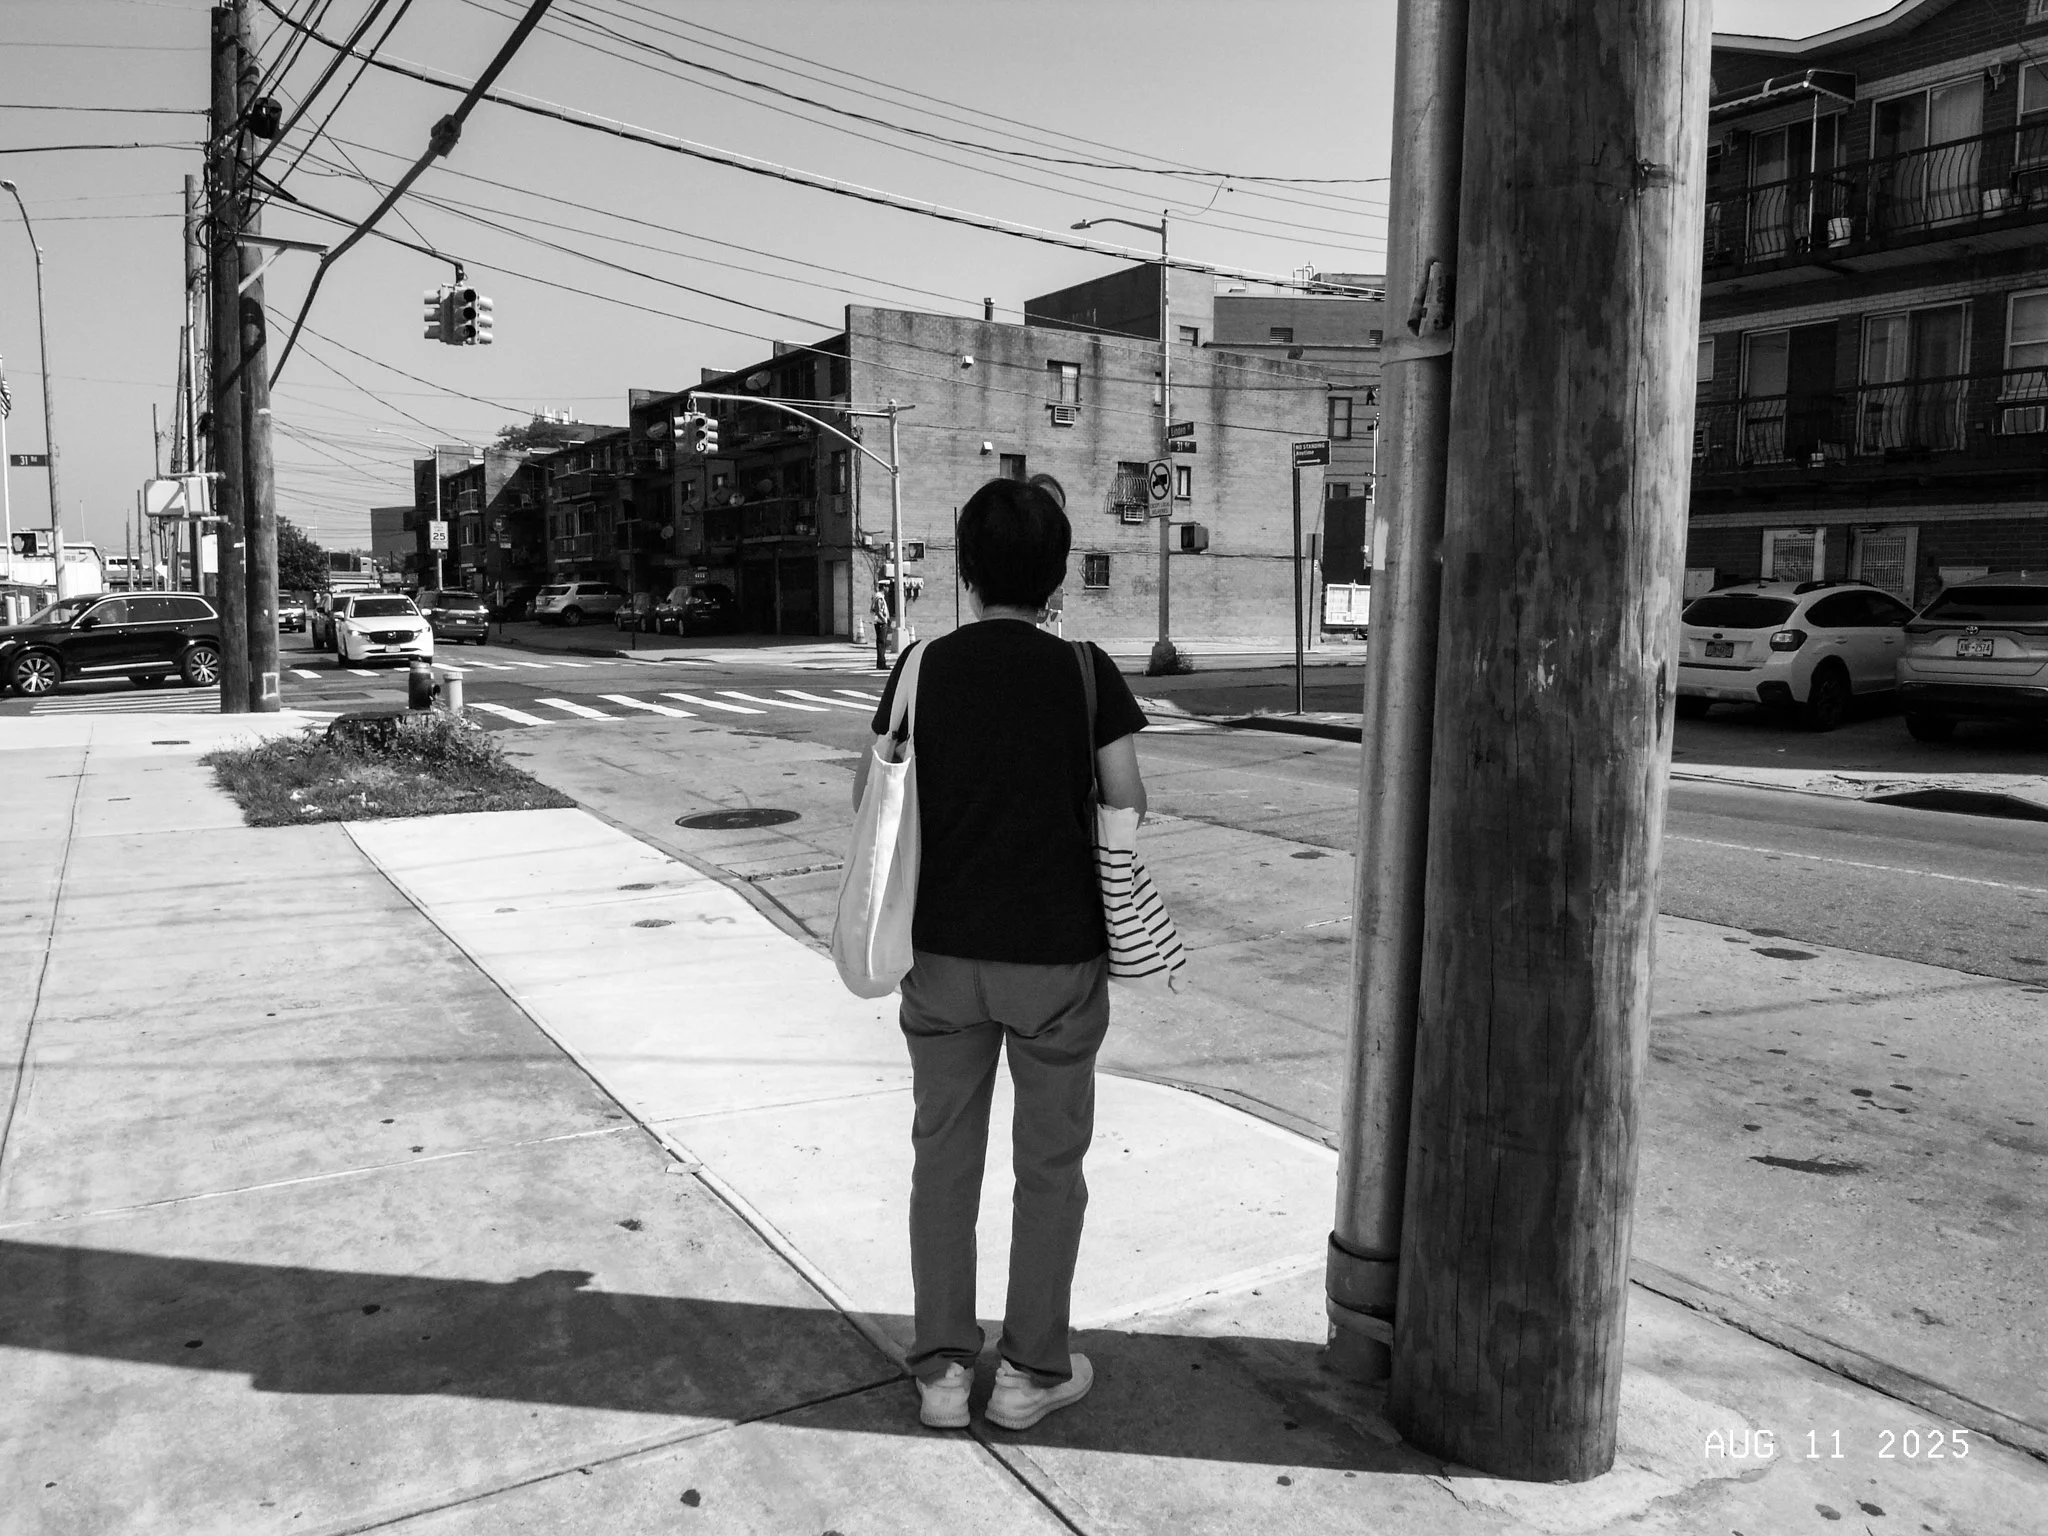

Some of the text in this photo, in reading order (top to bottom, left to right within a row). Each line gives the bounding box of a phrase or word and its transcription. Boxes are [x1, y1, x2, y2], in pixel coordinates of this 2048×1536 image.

[1177, 441, 1183, 452] 31
[20, 456, 28, 466] 31
[433, 532, 446, 541] 25
